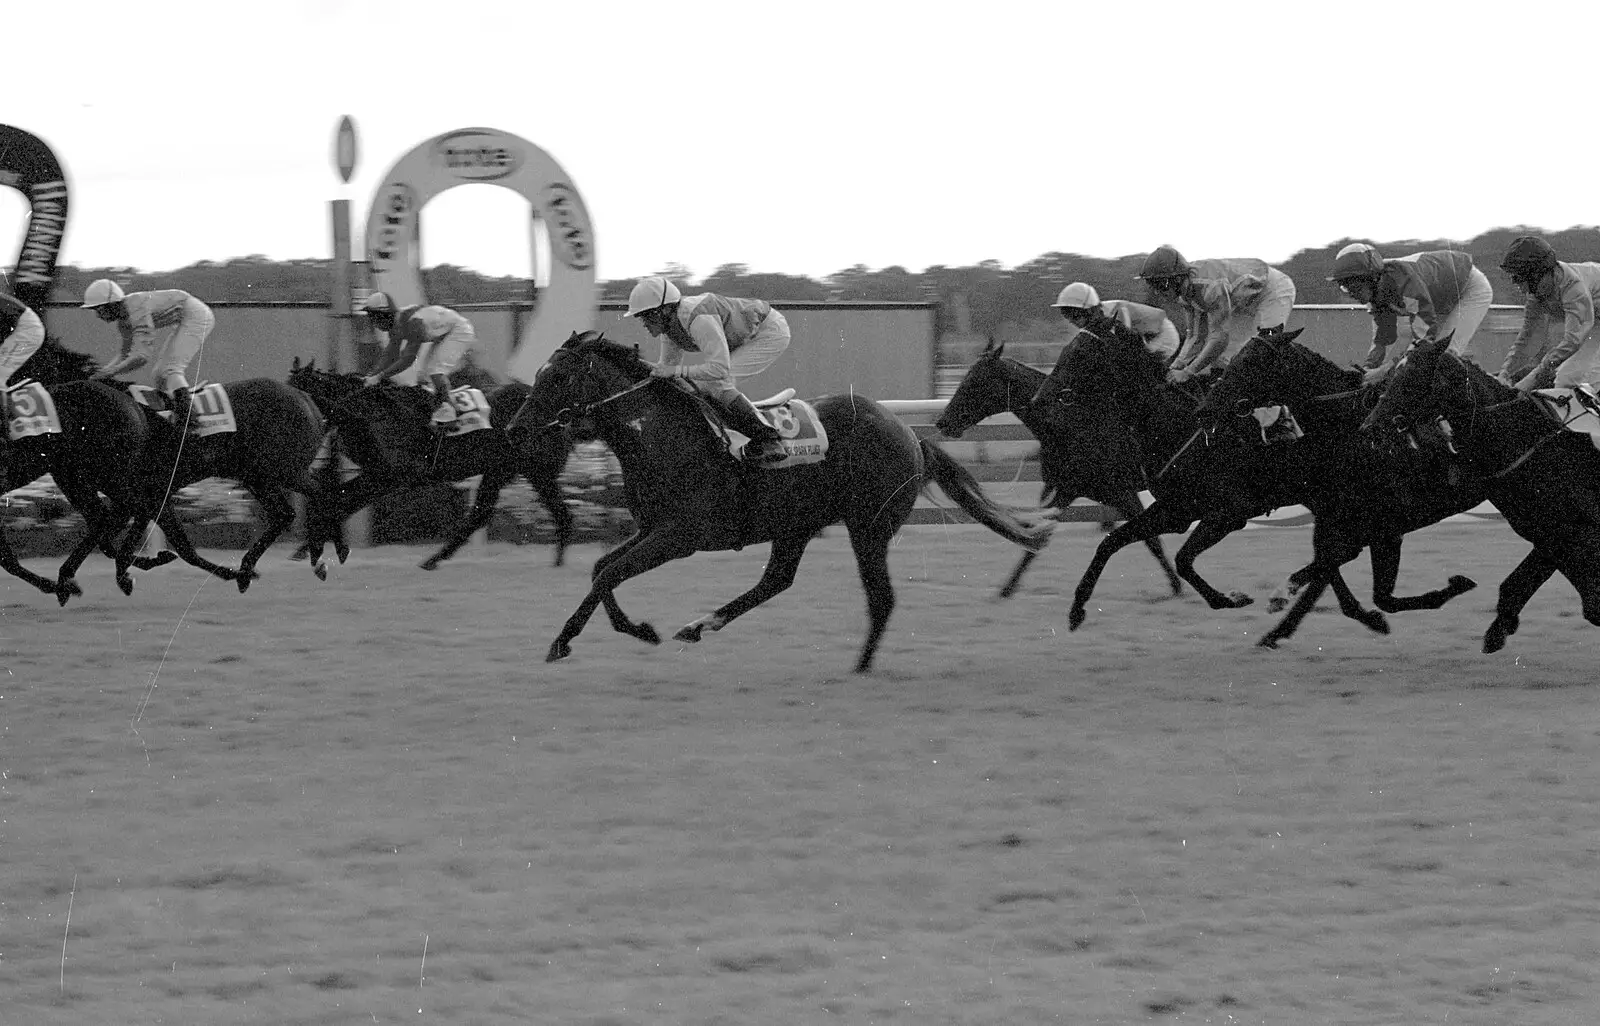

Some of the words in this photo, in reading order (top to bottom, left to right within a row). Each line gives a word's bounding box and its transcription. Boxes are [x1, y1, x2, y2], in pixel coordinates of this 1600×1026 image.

[11, 389, 37, 416] 5
[192, 389, 221, 414] 11
[454, 390, 476, 412] 3
[769, 406, 800, 439] 8
